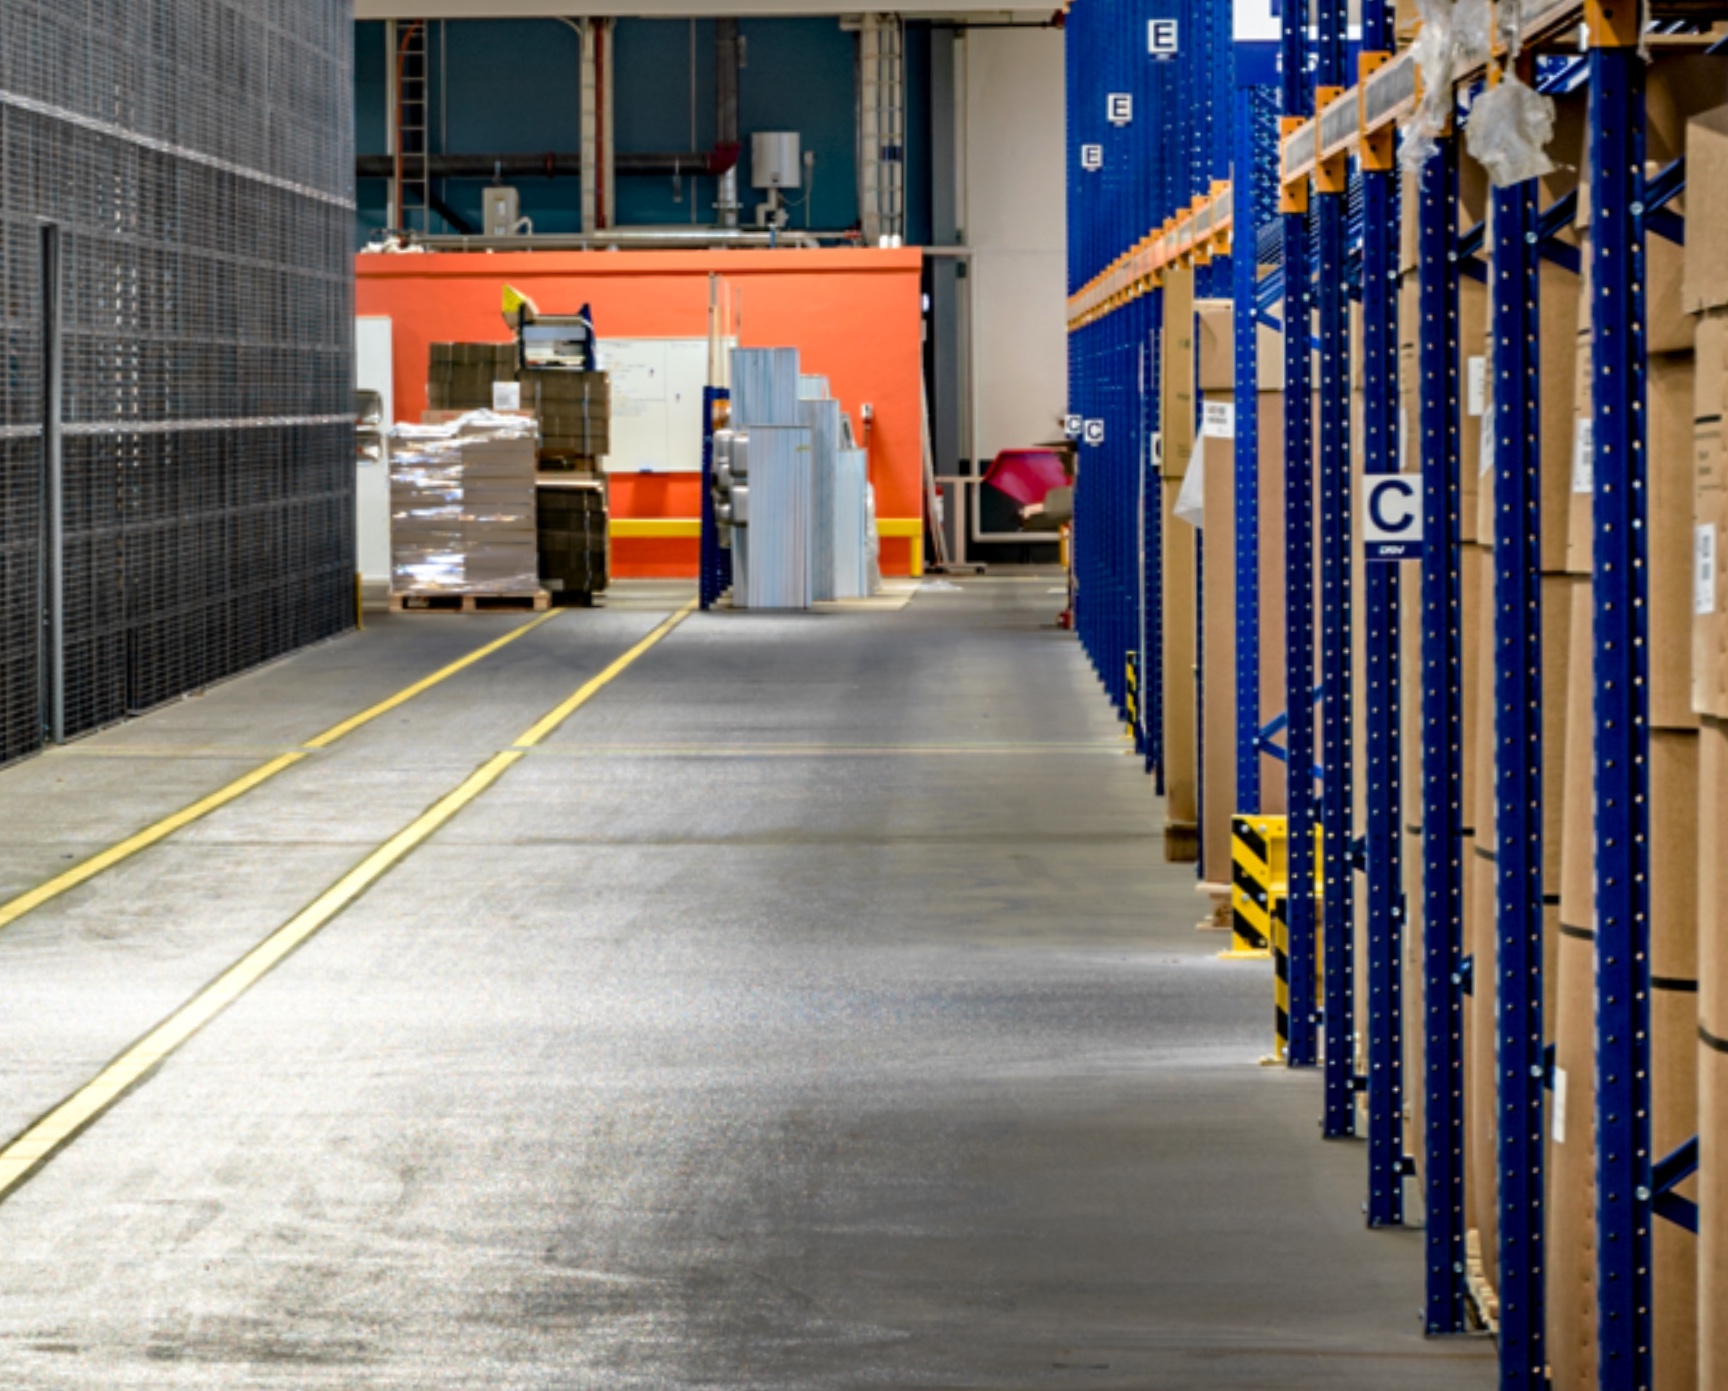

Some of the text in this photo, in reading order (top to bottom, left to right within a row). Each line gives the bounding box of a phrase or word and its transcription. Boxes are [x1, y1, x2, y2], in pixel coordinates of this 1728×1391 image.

[1154, 22, 1173, 48] E
[1113, 97, 1128, 117] E
[1086, 147, 1098, 164] E
[1087, 422, 1102, 439] C
[1369, 479, 1413, 533] C
